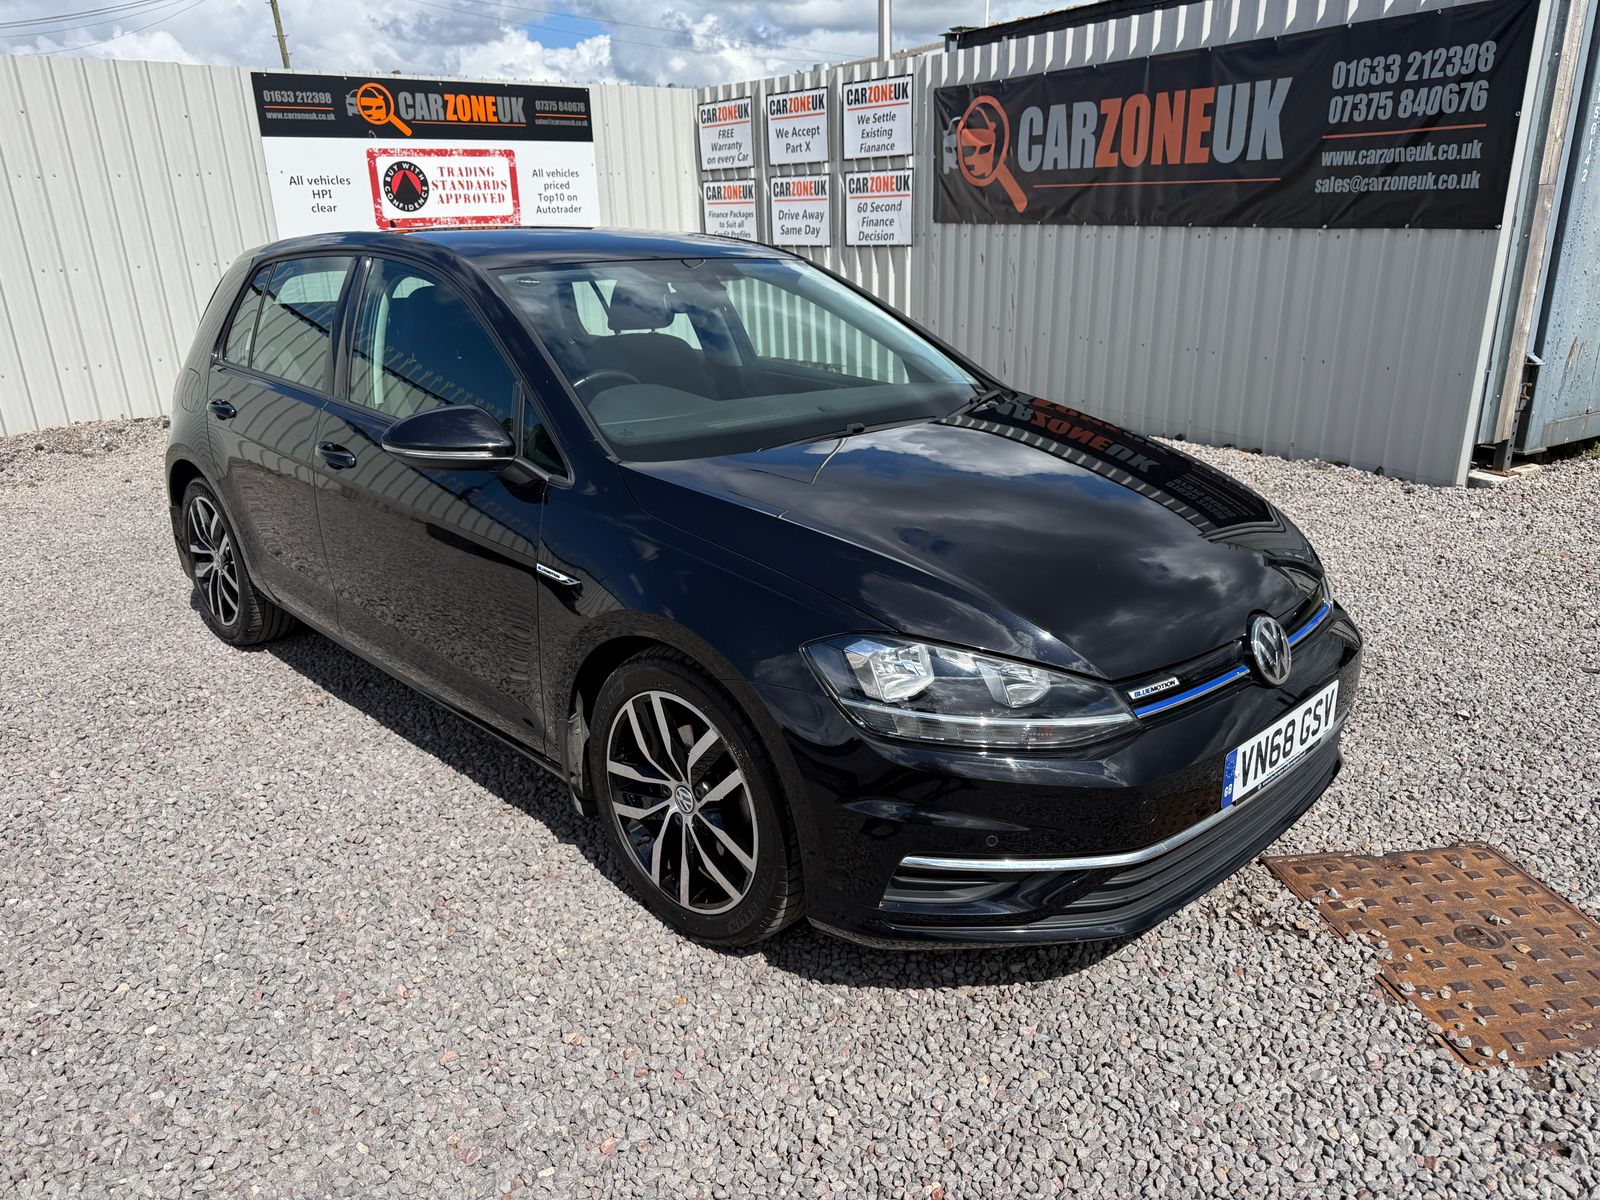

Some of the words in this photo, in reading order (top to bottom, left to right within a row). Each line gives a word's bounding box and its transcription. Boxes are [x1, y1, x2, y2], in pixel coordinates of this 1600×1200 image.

[1332, 54, 1401, 90] 01633
[1405, 40, 1497, 82] 212398
[263, 90, 294, 102] 01633
[296, 91, 332, 103] 212398
[846, 82, 909, 106] CARZONEUK
[398, 90, 526, 124] CARZONEUK
[769, 93, 825, 116] CARZONEUK
[1328, 91, 1393, 124] 07375
[1398, 80, 1489, 118] 840676
[266, 112, 335, 120] www.carzoneuk.co.uk
[701, 103, 749, 124] CARZONEUK
[857, 114, 871, 125] We
[873, 111, 896, 123] Settle
[1017, 77, 1292, 173] CARZONEUK
[718, 129, 734, 139] FREE
[776, 128, 790, 138] We
[791, 125, 820, 139] Accept
[861, 127, 893, 140] Existing
[711, 141, 743, 152] Warranty
[785, 142, 802, 153] Part
[804, 141, 811, 152] X
[859, 142, 895, 153] Fianance
[1321, 139, 1482, 167] www.carzoneuk.co.uk
[717, 156, 736, 165] every
[737, 152, 749, 161] Car
[385, 165, 398, 182] BUY
[402, 163, 425, 181] WITH
[437, 166, 494, 177] TRADING
[532, 168, 544, 178] All
[547, 168, 579, 179] vehicles
[289, 175, 304, 186] All
[307, 175, 351, 186] vehicles
[431, 179, 508, 191] STANDARDS
[544, 180, 570, 192] priced
[848, 174, 910, 194] CARZONEUK
[1315, 170, 1480, 193] sales@carzoneuk.co.uk
[312, 189, 332, 200] HPI
[706, 184, 754, 201] CARZONEUK
[773, 179, 827, 197] CARZONEUK
[385, 185, 428, 210] CONFIDENCE
[438, 193, 505, 204] APPROVED
[567, 194, 578, 202] on
[311, 202, 337, 213] clear
[536, 204, 582, 214] Autotrader
[857, 202, 868, 213] 60
[870, 200, 902, 212] Second
[730, 209, 753, 220] Packages
[778, 209, 800, 220] Drive
[801, 209, 825, 222] Away
[861, 216, 895, 227] Finance
[780, 224, 802, 235] Same
[804, 224, 821, 238] Day
[859, 230, 895, 241] Decision
[1134, 679, 1176, 697] BLUEMOTION
[1241, 718, 1296, 788] VN68
[1299, 689, 1335, 746] GSV
